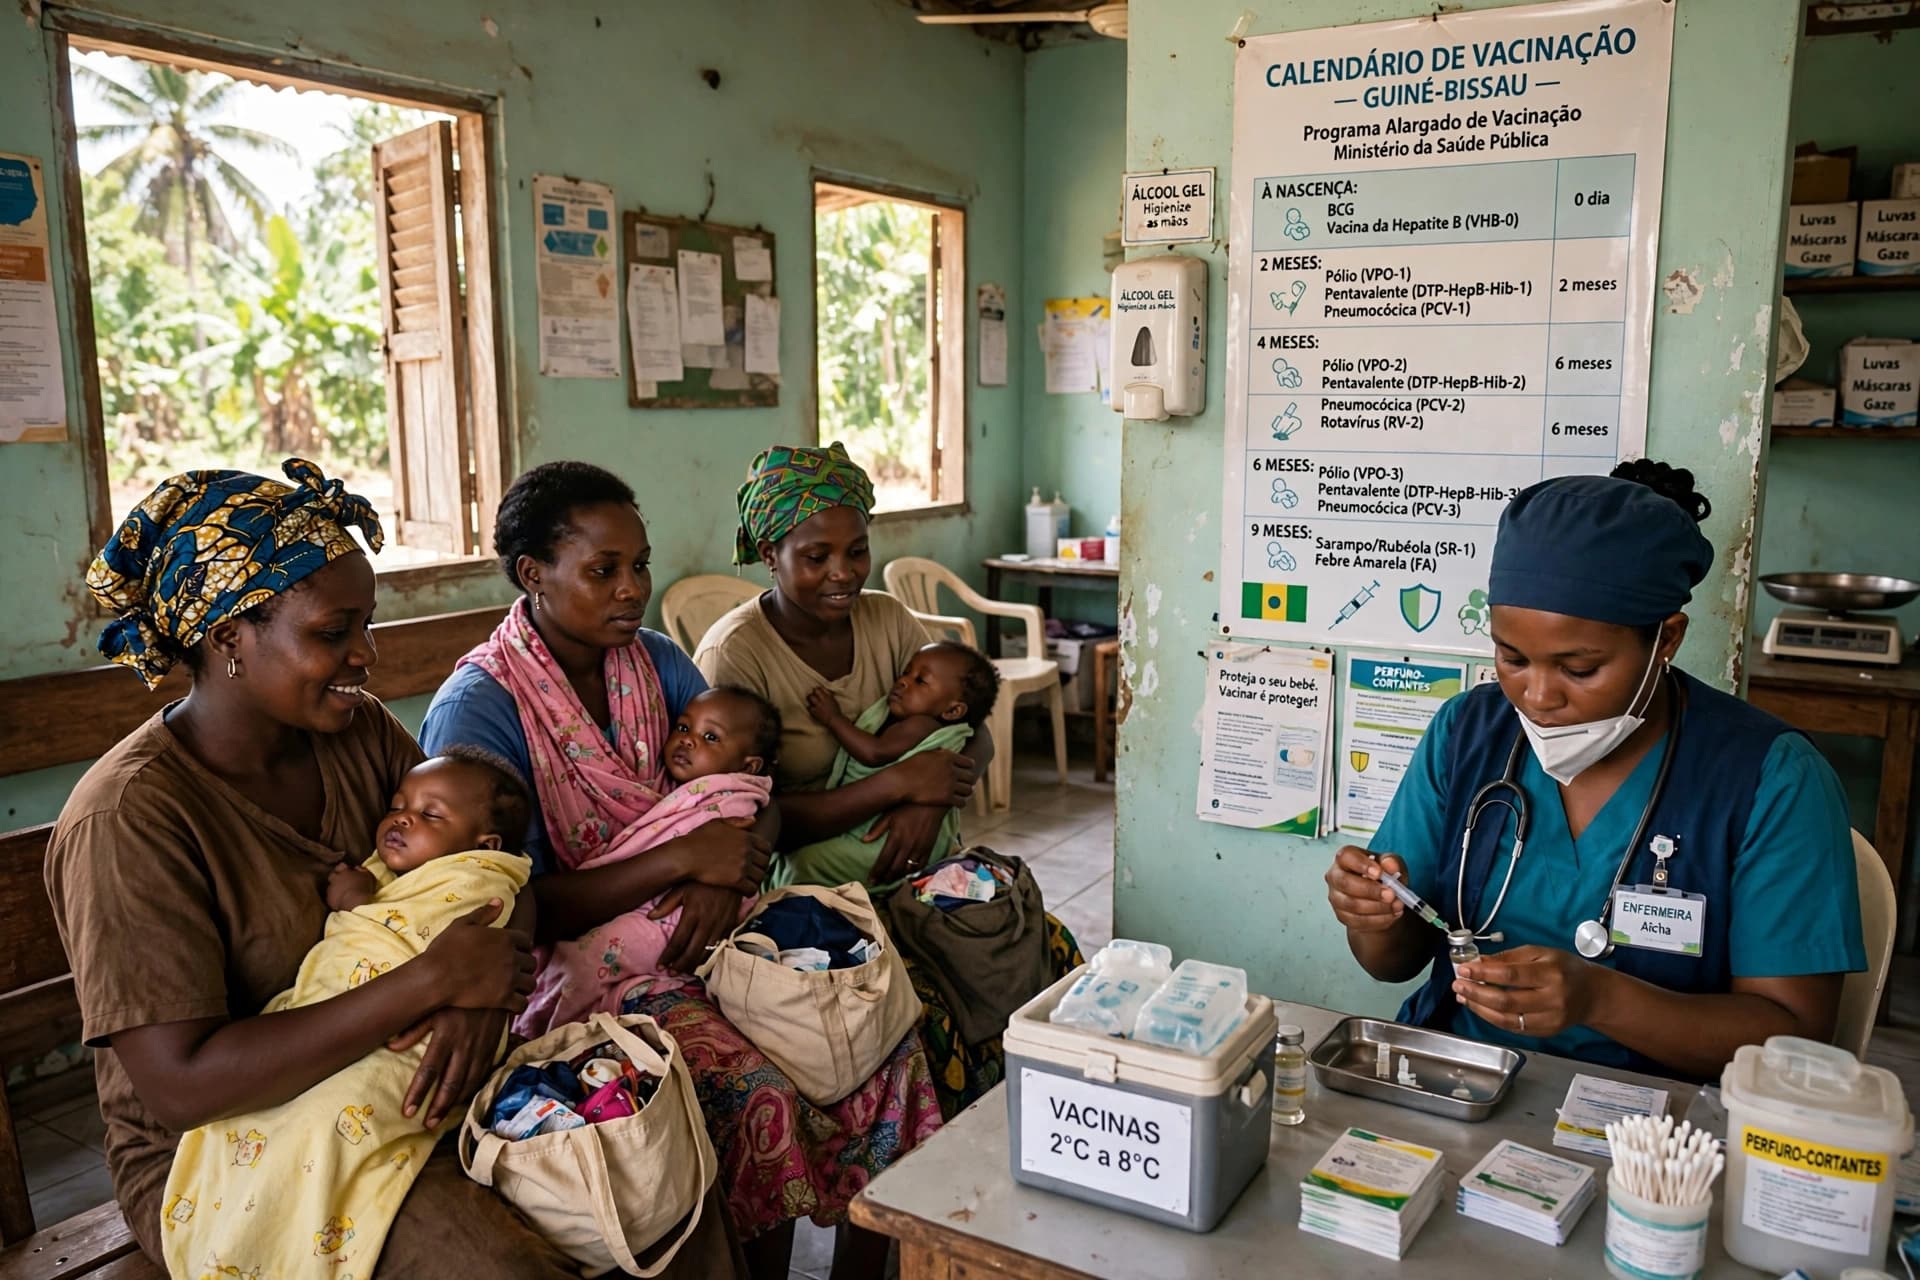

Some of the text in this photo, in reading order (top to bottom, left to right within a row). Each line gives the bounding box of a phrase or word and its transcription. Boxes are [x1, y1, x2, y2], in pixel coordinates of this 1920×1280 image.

[1266, 24, 1636, 88] CALENDÁRIO DE VACINAÇÃO
[1363, 73, 1527, 108] GUINÉ-BISSAU
[1304, 105, 1582, 143] Programa Alargado de Vacinação
[1334, 131, 1549, 160] Ministério da Saúde Pública
[1132, 184, 1205, 200] ÁLCOOL GEL
[1262, 180, 1358, 200] À NASCENÇA:
[1574, 190, 1610, 206] 0 dia
[1144, 201, 1191, 216] Higienize
[1328, 203, 1354, 217] BCG
[1877, 210, 1916, 223] Luvas
[1146, 219, 1159, 228] as
[1327, 212, 1519, 234] Vacina da Hepatite B (VHB-0)
[1800, 213, 1836, 226] Luvas
[1790, 233, 1847, 246] Máscaras
[1866, 229, 1920, 242] Máscara
[1800, 251, 1832, 263] Gaze
[1877, 248, 1910, 260] Gaze
[1260, 255, 1322, 271] 2 MESES:
[1325, 266, 1411, 284] Pólio (VPO-1)
[1325, 280, 1532, 300] Pentavalente (DTP-HepB-Hib-1)
[1559, 279, 1617, 292] 2 meses
[1121, 289, 1174, 301] ÁLCOOL GEL
[1324, 301, 1471, 318] Pneumocócica (PCV-1)
[1257, 335, 1319, 349] 4 MESES:
[1322, 358, 1407, 373] Pólio (VPO-2)
[1555, 356, 1612, 370] 6 meses
[1863, 357, 1900, 370] Luvas
[1322, 375, 1526, 391] Pentavalente (DTP-HepB-Hib-2)
[1853, 379, 1911, 392] Máscaras
[1321, 398, 1465, 414] Pneumocócica (PCV-2)
[1863, 397, 1896, 411] Gaze
[1320, 415, 1424, 431] Rotavírus (RV-2)
[1551, 422, 1608, 436] 6 meses
[1253, 458, 1315, 473] 6 MESES:
[1319, 466, 1404, 483] Pólio (VPO-3)
[1318, 483, 1400, 497] Pentavalente
[1318, 499, 1461, 519] Pneumocócica (PCV-3)
[1251, 523, 1312, 539] 9 MESES:
[1316, 537, 1476, 559] Sarampo/Rubéola (SR-1)
[1315, 552, 1437, 573] Febre Amarela (FA)
[1219, 669, 1318, 691] Proteja o seu bebé.
[1374, 666, 1424, 680] PERFURO-
[1372, 678, 1431, 692] CORTANTES
[1219, 685, 1318, 709] Vacinar é proteger!
[1623, 901, 1693, 921] ENFERMEIRA
[1050, 1096, 1160, 1145] VACINAS
[1098, 1149, 1110, 1167] a
[1745, 1132, 1882, 1176] PERFURO-CORTANTES
